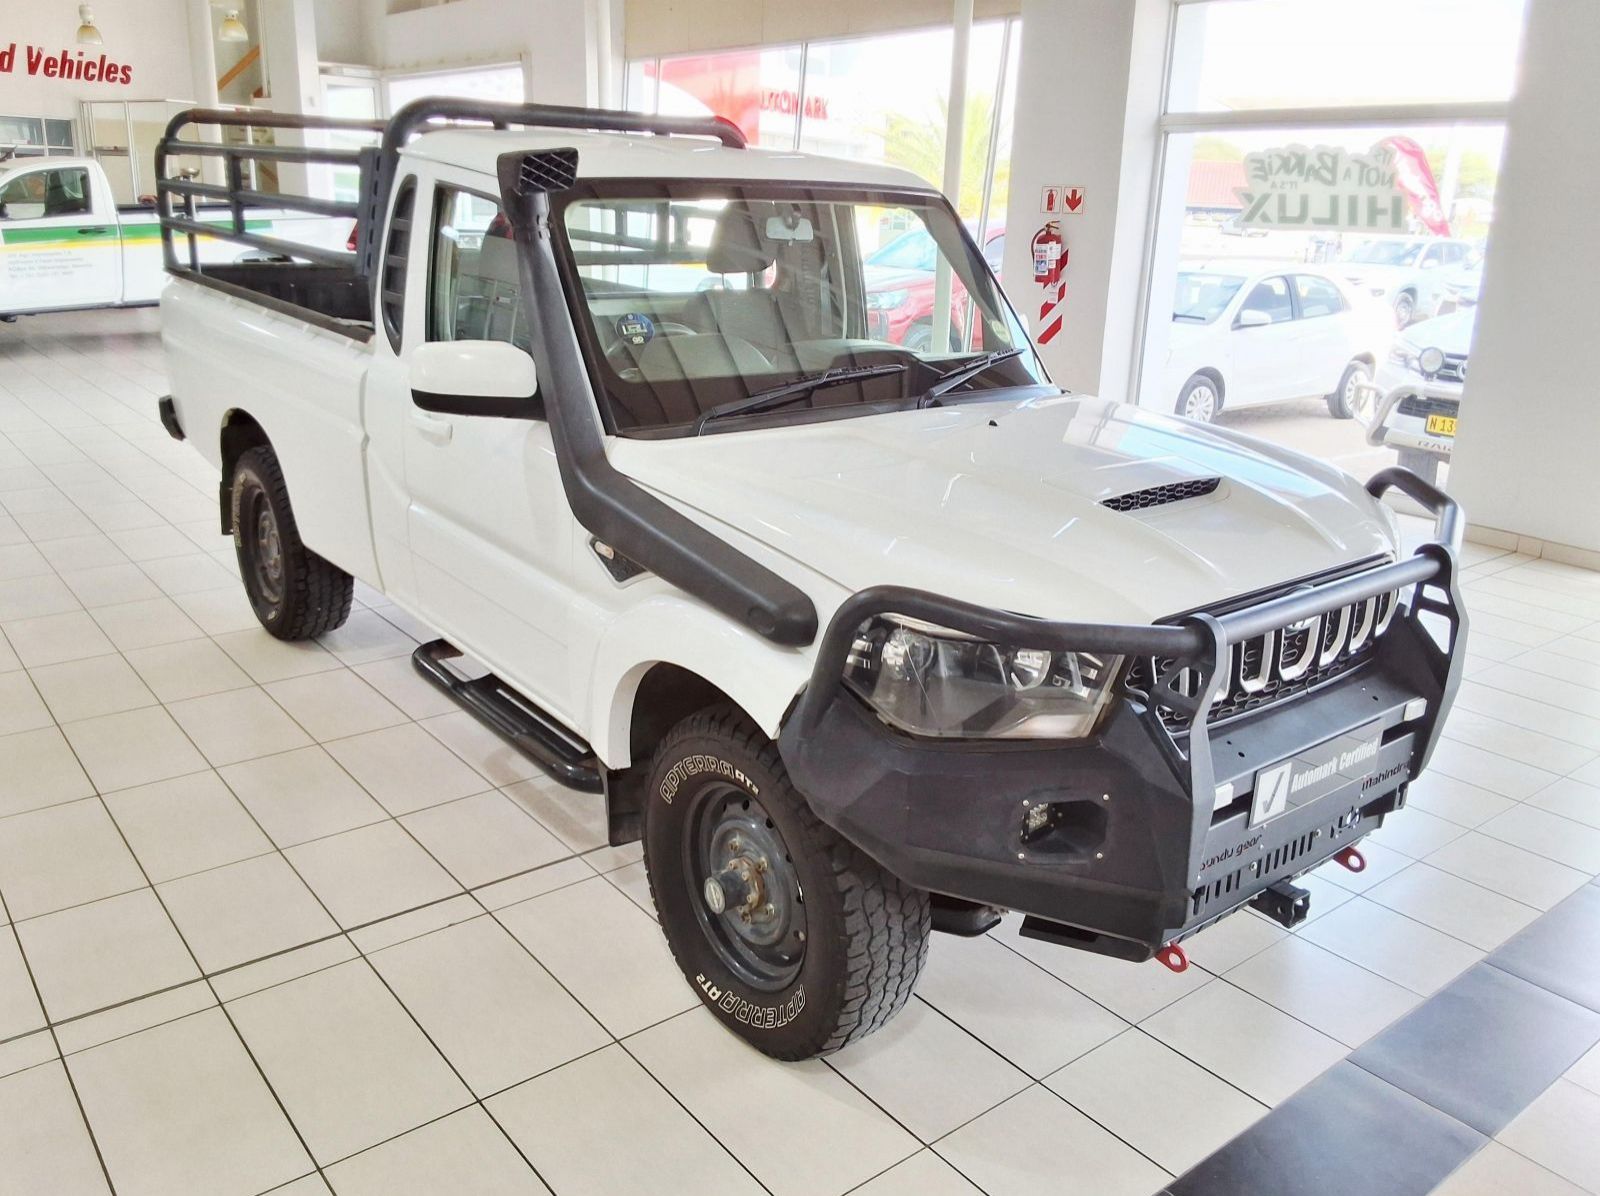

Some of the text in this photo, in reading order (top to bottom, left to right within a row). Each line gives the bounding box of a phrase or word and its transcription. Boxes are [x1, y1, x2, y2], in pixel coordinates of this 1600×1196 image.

[27, 46, 132, 85] Vehicles
[1429, 417, 1456, 433] N 13
[659, 754, 735, 805] APTERRA
[1291, 737, 1379, 793] Automark Certified
[1236, 834, 1263, 857] gear
[718, 983, 806, 1029] APTERRA
